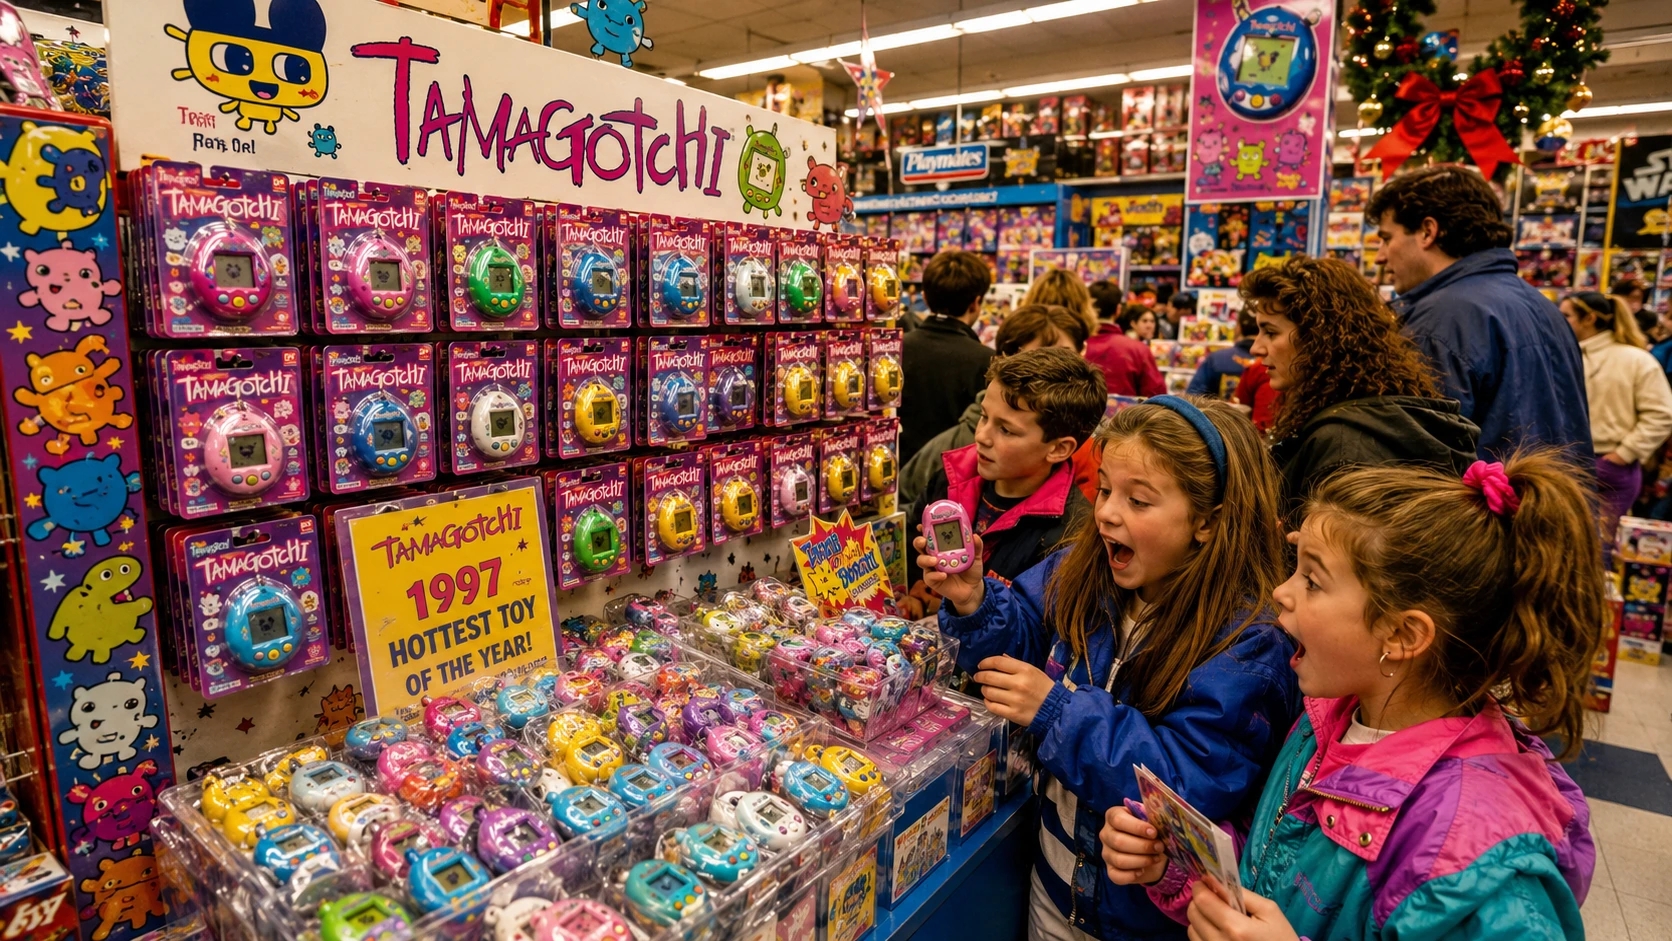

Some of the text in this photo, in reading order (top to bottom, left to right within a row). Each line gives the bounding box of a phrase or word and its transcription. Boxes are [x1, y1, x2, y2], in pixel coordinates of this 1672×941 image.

[350, 36, 731, 196] TAMAGOTCHI
[906, 150, 983, 174] Playmates
[161, 187, 285, 221] TAMAGOTCHI
[325, 201, 422, 230] TAMAGOTCHI
[452, 213, 531, 238] TAMAGOTCHI
[177, 370, 293, 402] TAMAGOTCHI
[331, 363, 426, 392] TAMAGOTCHI
[455, 358, 532, 383] TAMAGOTCHI
[371, 504, 523, 569] TAMAGOTCHI
[196, 538, 312, 585] TAMAGOTCHI
[406, 556, 503, 621] 1997
[388, 609, 491, 668] HOTTEST
[497, 595, 536, 628] TOY
[405, 667, 432, 696] OF
[436, 653, 475, 685] THE
[477, 631, 533, 668] YEAR!
